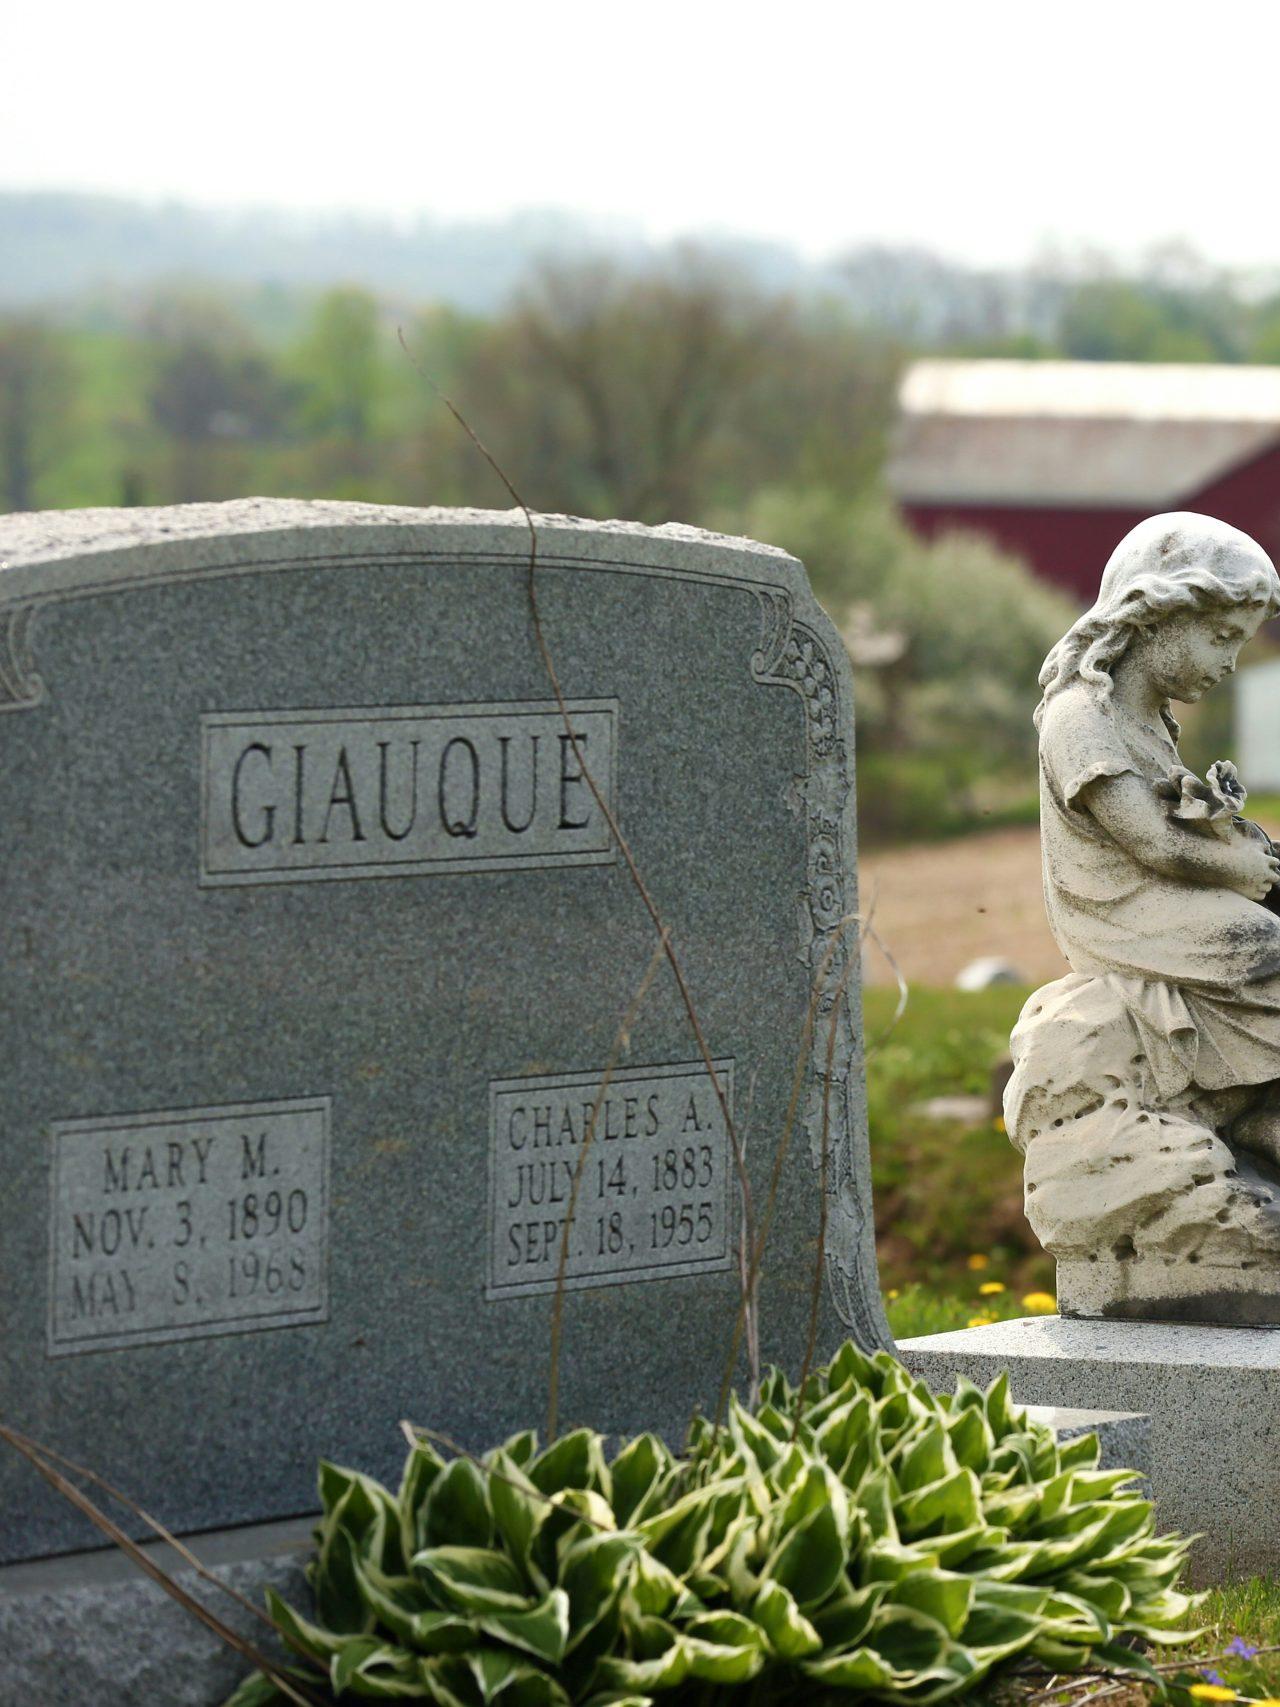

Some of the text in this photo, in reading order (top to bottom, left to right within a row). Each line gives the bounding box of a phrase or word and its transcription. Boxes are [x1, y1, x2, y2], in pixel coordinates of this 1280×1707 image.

[231, 733, 590, 848] GIAUQUE
[508, 1091, 713, 1150] CHARLES A.
[104, 1132, 280, 1195] MARY M.
[508, 1145, 713, 1208] JULY 14, 1883
[72, 1206, 155, 1259] NOV.
[228, 1188, 308, 1241] 1890
[507, 1202, 713, 1267] SEPT. 18, 1955
[70, 1265, 142, 1320] MAY
[228, 1249, 307, 1299] 1968
